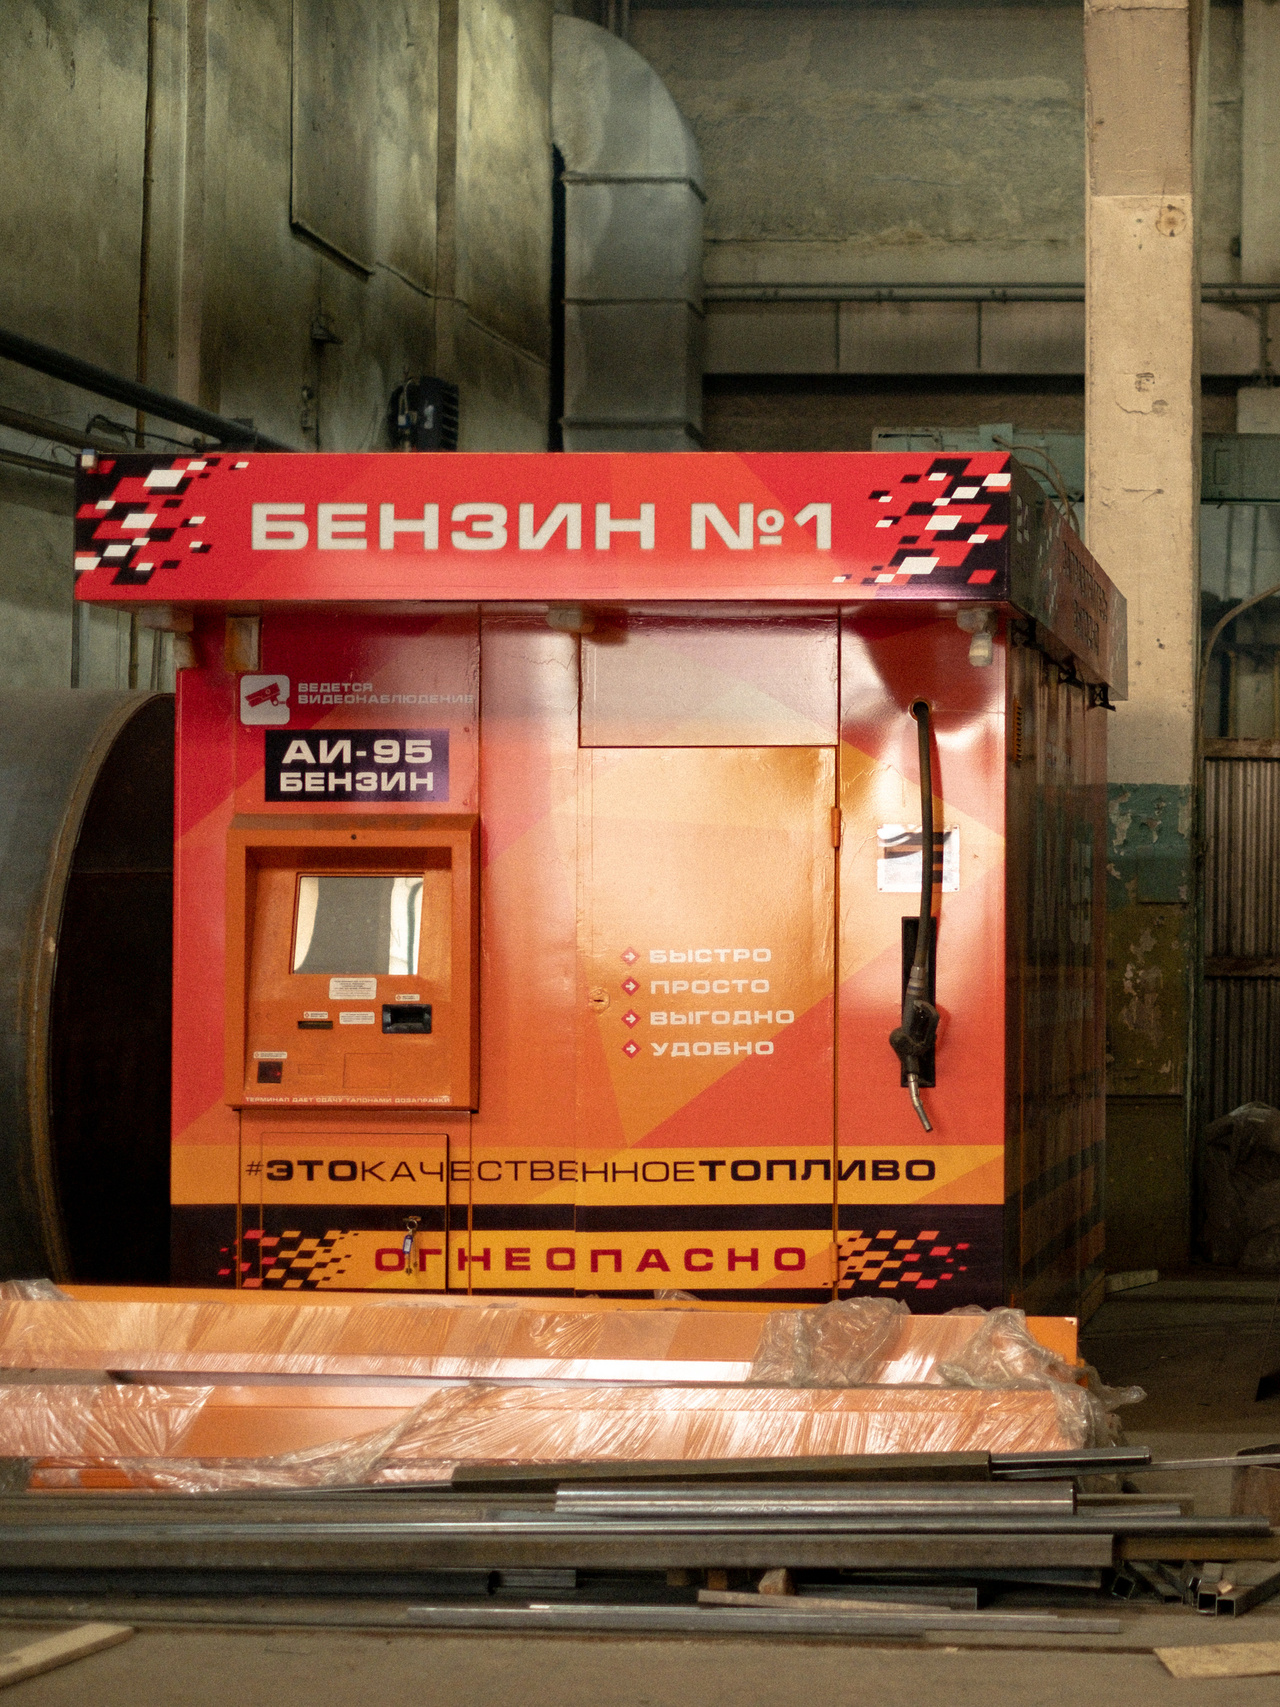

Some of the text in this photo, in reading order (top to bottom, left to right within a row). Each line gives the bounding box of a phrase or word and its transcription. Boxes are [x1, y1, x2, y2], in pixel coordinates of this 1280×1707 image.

[251, 502, 834, 552] БЕНЗИН №1
[298, 682, 373, 693] ВЕДЕТСЯ
[298, 694, 475, 705] ВИДЕОНАБЛЮДЕНИЕ
[282, 739, 433, 764] АИ-95
[280, 772, 434, 792] БЕНЗИН
[650, 948, 772, 964] БЫСТРО
[650, 979, 770, 994] ПРОСТО
[650, 1010, 795, 1025] ВЫГОДНО
[650, 1041, 775, 1057] УДОБНО
[374, 1247, 808, 1273] ОГНЕОПАСНО
